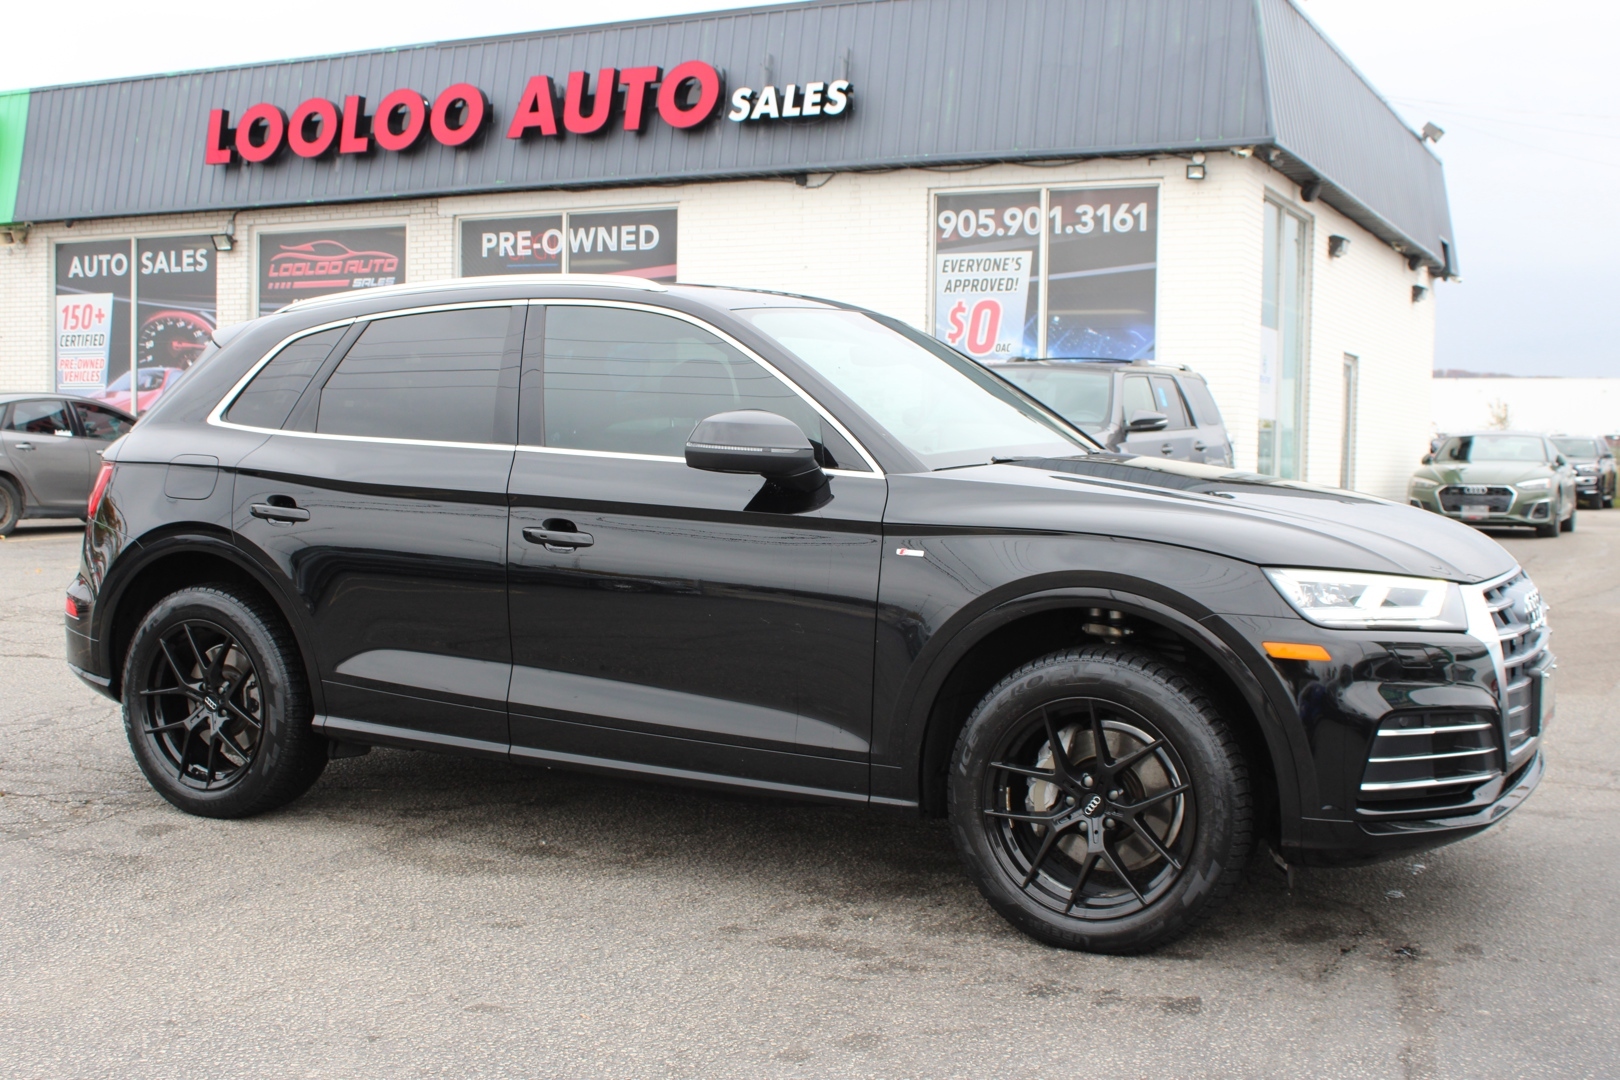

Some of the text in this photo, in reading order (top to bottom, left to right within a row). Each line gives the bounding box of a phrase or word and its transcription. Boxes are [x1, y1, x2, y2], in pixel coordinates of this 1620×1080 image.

[205, 60, 850, 166] LOOLOO AUTO SALES
[937, 202, 1148, 239] 905.901.3161
[482, 224, 660, 258] PRE-OWNED
[68, 248, 208, 279] AUTO SALES
[268, 258, 399, 277] LOOLOO AUTO
[942, 256, 1022, 274] EVERYONE'S
[352, 276, 396, 288] SALES
[944, 277, 1019, 294] APPROVED!
[62, 303, 105, 330] 150+
[948, 299, 1002, 355] $0
[60, 333, 105, 347] CERTIFIED
[995, 343, 1011, 353] OAC
[60, 358, 105, 370] PRE-OWNED
[64, 370, 100, 382] VEHICLES
